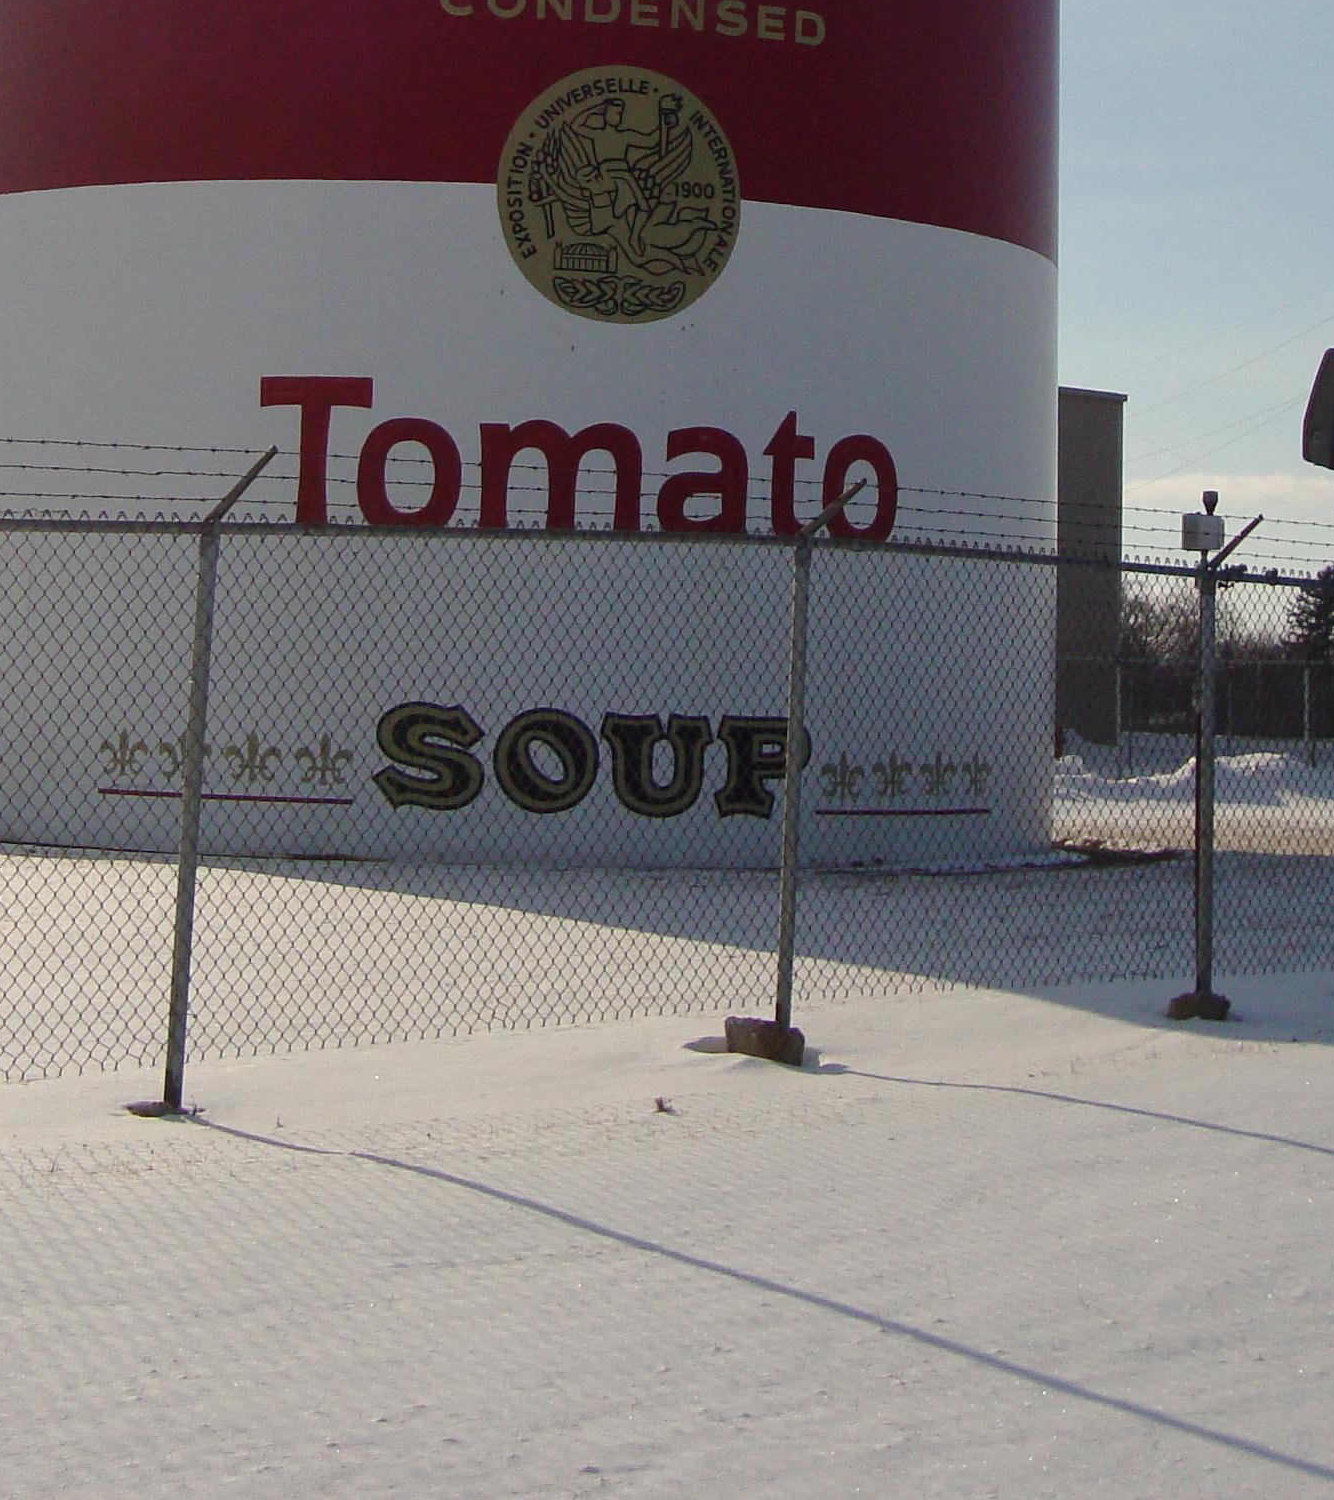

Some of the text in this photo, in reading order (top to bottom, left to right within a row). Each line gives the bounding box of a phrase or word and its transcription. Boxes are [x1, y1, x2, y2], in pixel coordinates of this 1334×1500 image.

[507, 77, 737, 273] EXPOSITION UNIVERSELLE INTERNATIONALE
[673, 181, 715, 199] 1900
[260, 375, 898, 542] Tomato
[372, 700, 812, 819] SOUP
